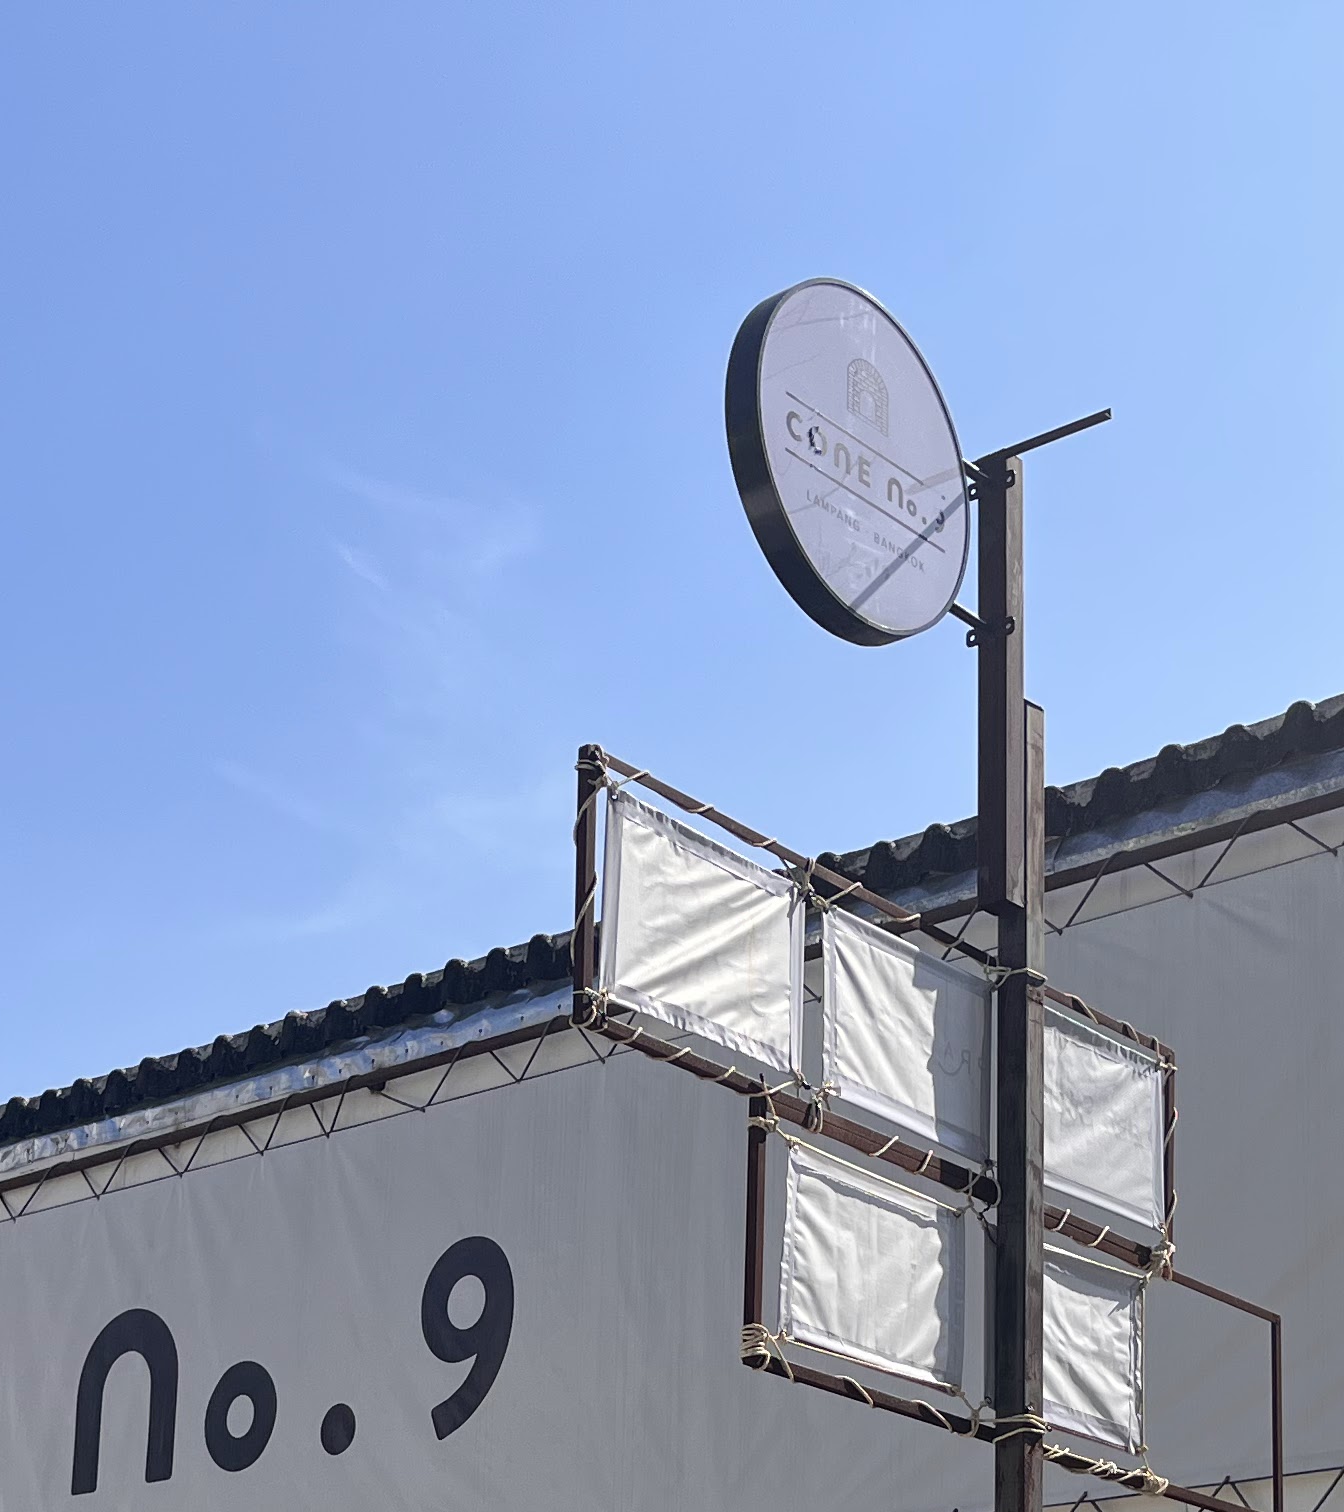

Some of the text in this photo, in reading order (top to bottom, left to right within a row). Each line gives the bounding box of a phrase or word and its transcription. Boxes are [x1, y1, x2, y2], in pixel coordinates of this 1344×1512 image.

[806, 489, 926, 573] LAMPANG BANGKOK
[420, 1234, 515, 1441] 9
